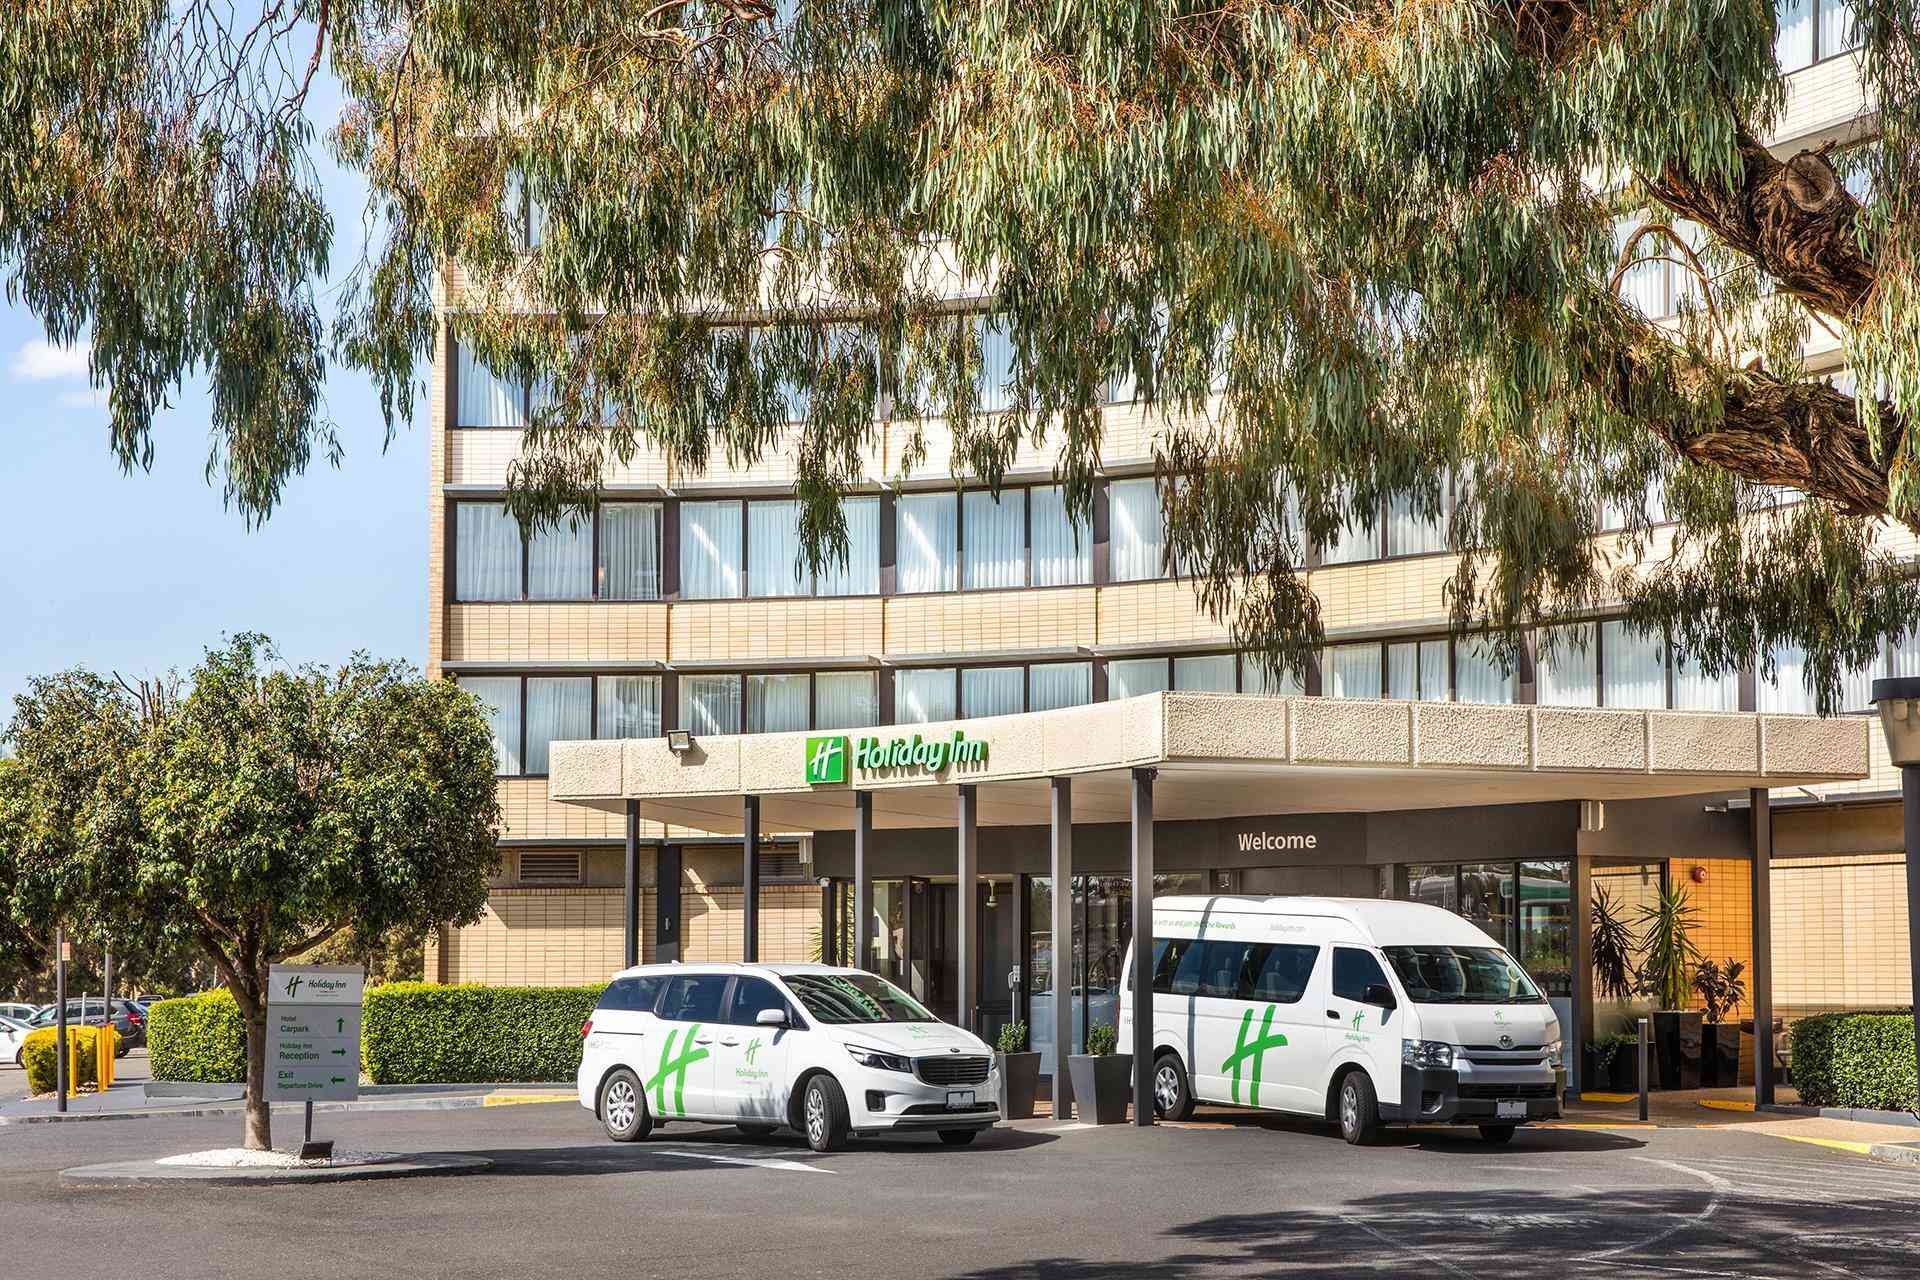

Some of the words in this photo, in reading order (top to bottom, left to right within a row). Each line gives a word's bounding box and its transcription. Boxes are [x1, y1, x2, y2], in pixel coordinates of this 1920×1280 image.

[854, 734, 946, 772] Holiday
[948, 730, 988, 762] Inn
[1238, 831, 1317, 851] Welcome
[308, 980, 335, 990] Holiday
[335, 980, 347, 989] Inn
[280, 1025, 309, 1034] Carpark
[279, 1050, 320, 1061] Reception
[278, 1070, 294, 1079] Exit
[735, 1067, 758, 1079] Holiday
